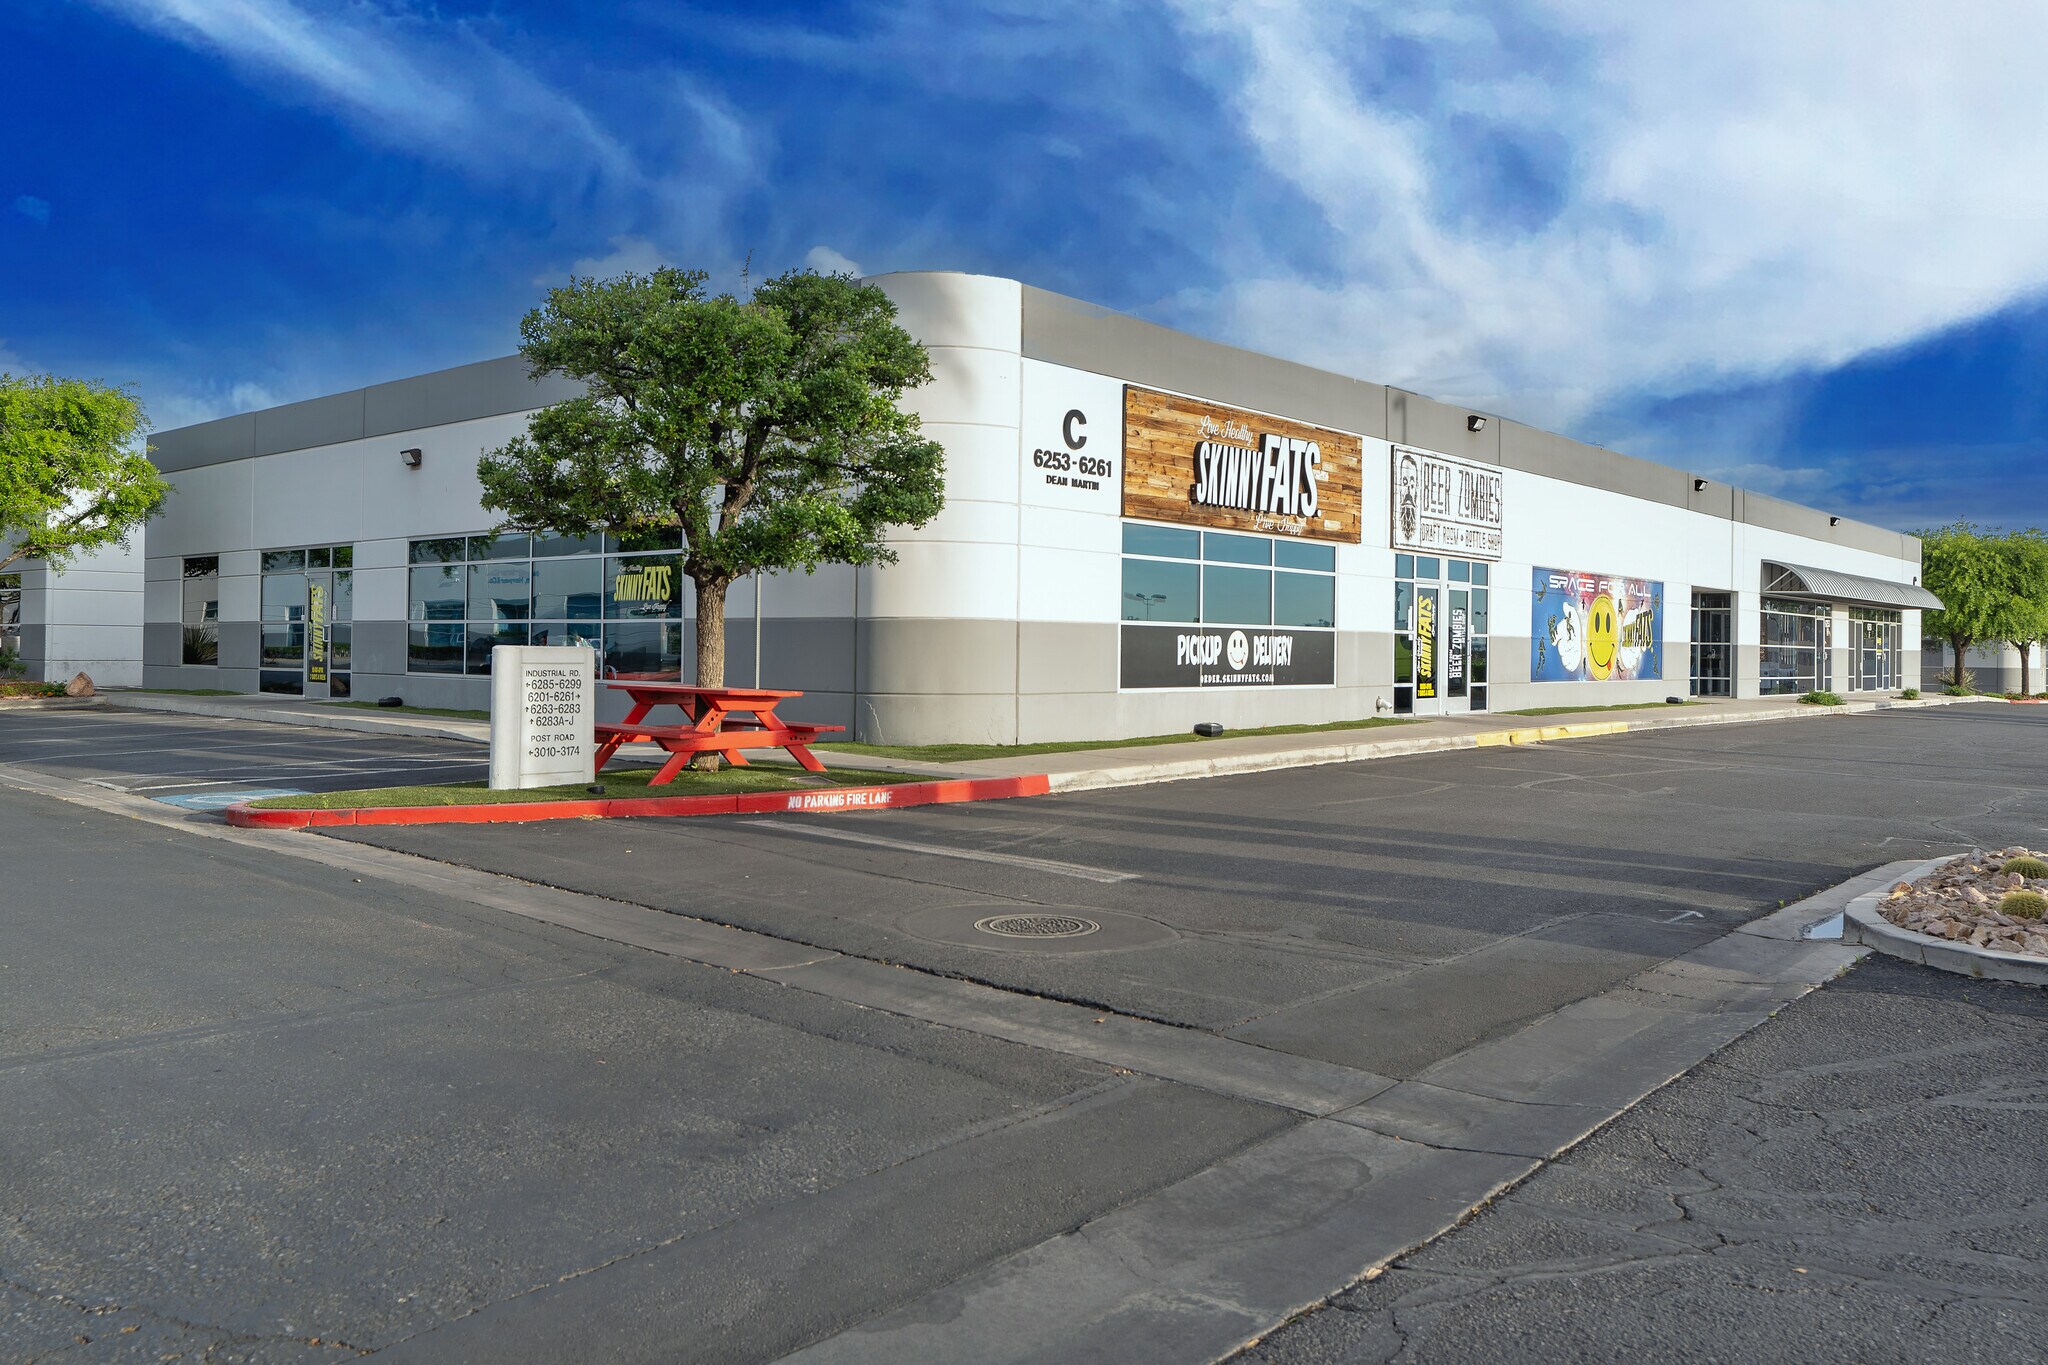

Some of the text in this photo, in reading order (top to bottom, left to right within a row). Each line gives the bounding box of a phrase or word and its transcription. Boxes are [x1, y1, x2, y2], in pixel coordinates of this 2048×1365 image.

[1062, 409, 1087, 450] C
[1197, 415, 1253, 446] Live Healthy
[1046, 475, 1100, 491] DEAN MARTIN
[1423, 462, 1501, 524] BEER ZOMBIES
[1253, 511, 1275, 531] Live
[1549, 575, 1595, 593] SPACE
[1628, 583, 1651, 597] ALL
[1177, 634, 1293, 666] PICKUP DELIVERY
[1452, 609, 1463, 678] BEER ZOMBIES
[525, 669, 581, 677] INDUSTRIAL RD.
[531, 679, 582, 690] 6285-6299
[528, 691, 575, 702] 6201-6261
[530, 703, 581, 714] 6263-6283
[535, 716, 574, 726] 6283A-J
[530, 733, 575, 742] POST ROAD
[534, 746, 580, 757] 3010-3174
[788, 796, 802, 809] NO
[804, 794, 845, 808] PARKING
[846, 792, 868, 806] FIRE
